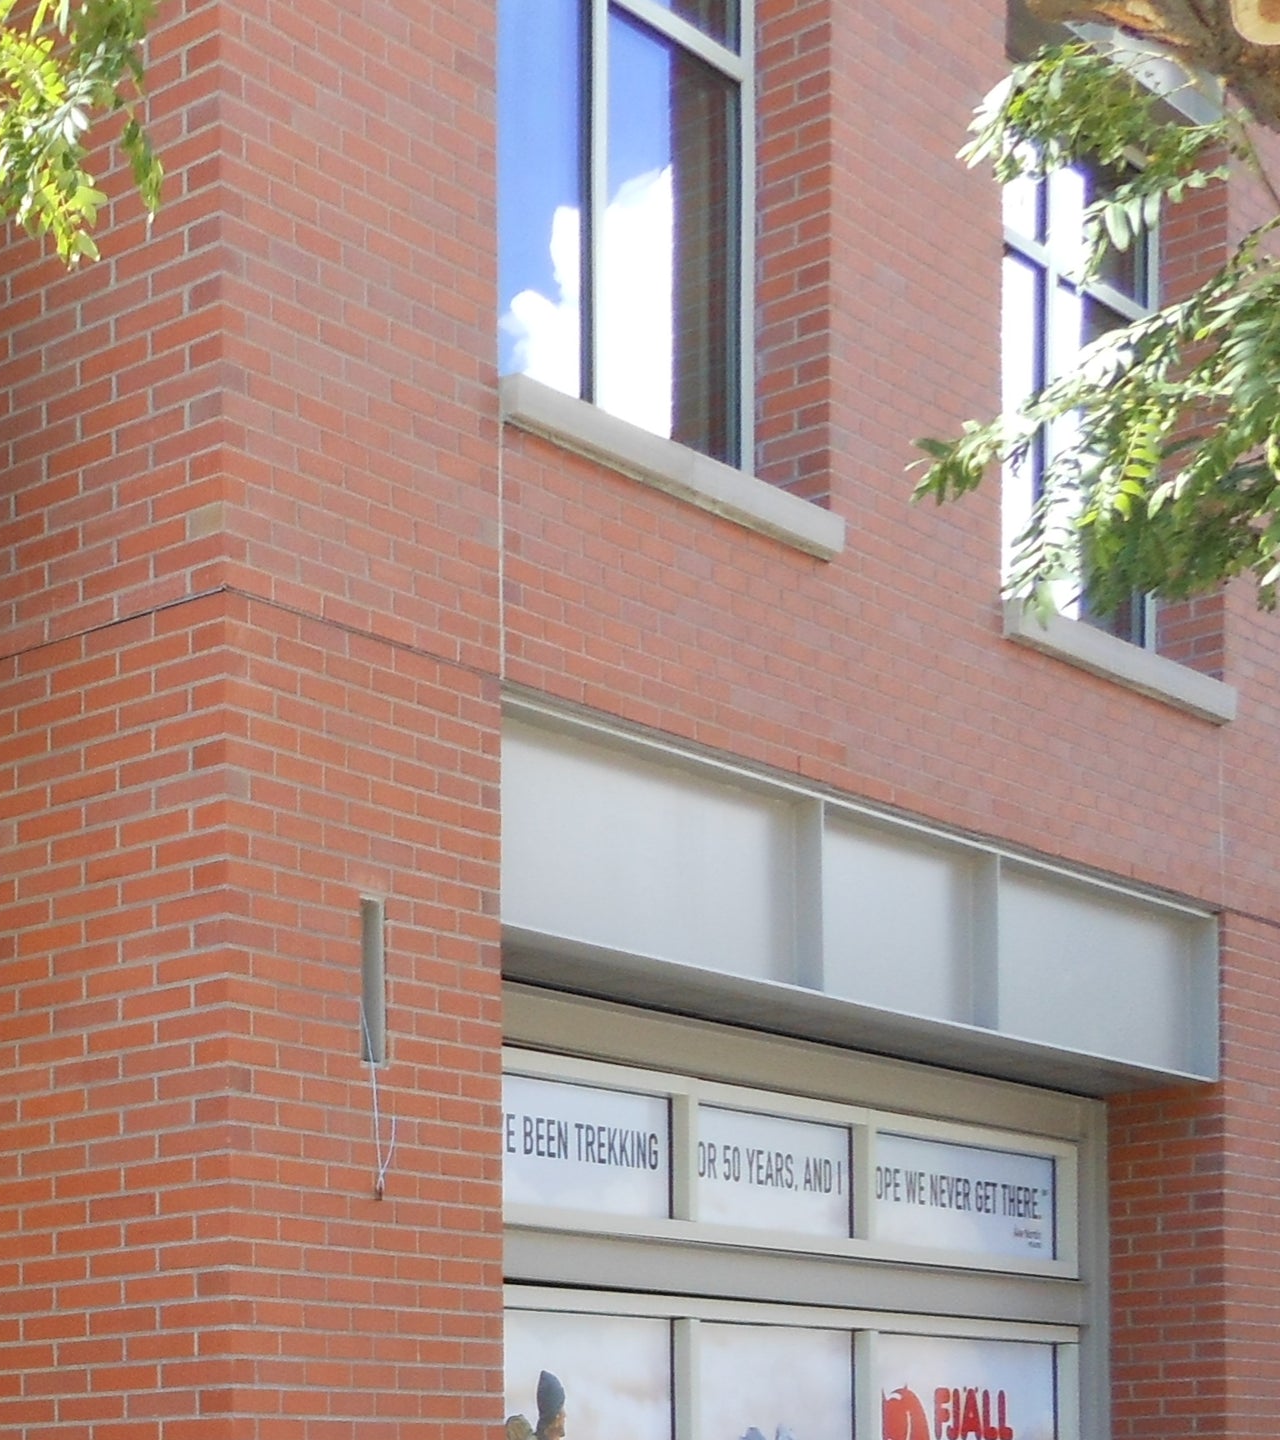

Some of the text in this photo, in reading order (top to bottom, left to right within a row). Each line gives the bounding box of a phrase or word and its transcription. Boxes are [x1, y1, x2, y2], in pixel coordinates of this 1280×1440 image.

[504, 1113, 658, 1170] E BEEN TREKKING
[723, 1145, 740, 1182] 50
[746, 1148, 798, 1192] YEARS,
[803, 1157, 832, 1194] AND
[905, 1170, 926, 1205] WE
[929, 1174, 971, 1211] NEVER
[975, 1180, 998, 1214] GET
